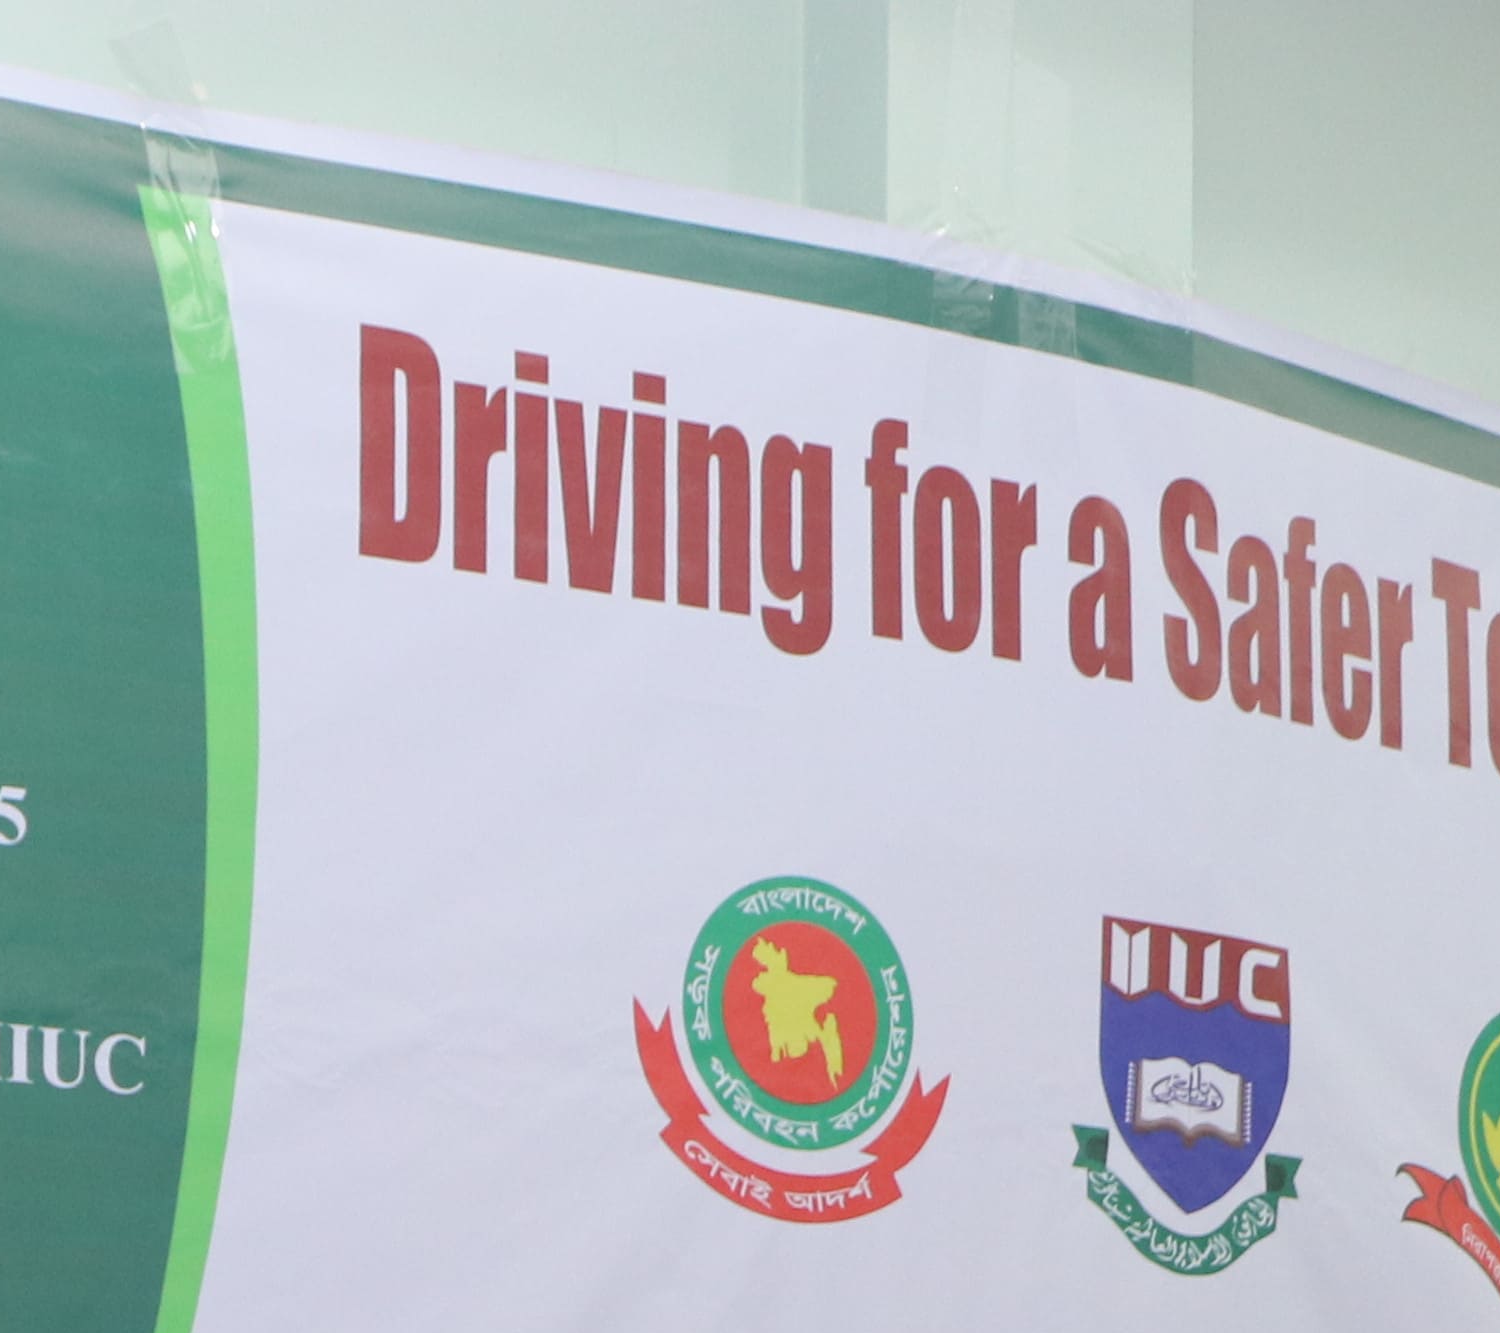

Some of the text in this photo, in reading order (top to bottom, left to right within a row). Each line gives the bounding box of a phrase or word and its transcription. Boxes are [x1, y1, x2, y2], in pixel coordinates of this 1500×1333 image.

[357, 323, 834, 657] Driving
[865, 416, 1037, 662] for
[1067, 493, 1134, 682] a
[1159, 476, 1412, 750] Safer
[736, 886, 867, 935] বাংলাদেশ
[1110, 921, 1283, 1018] IIUC
